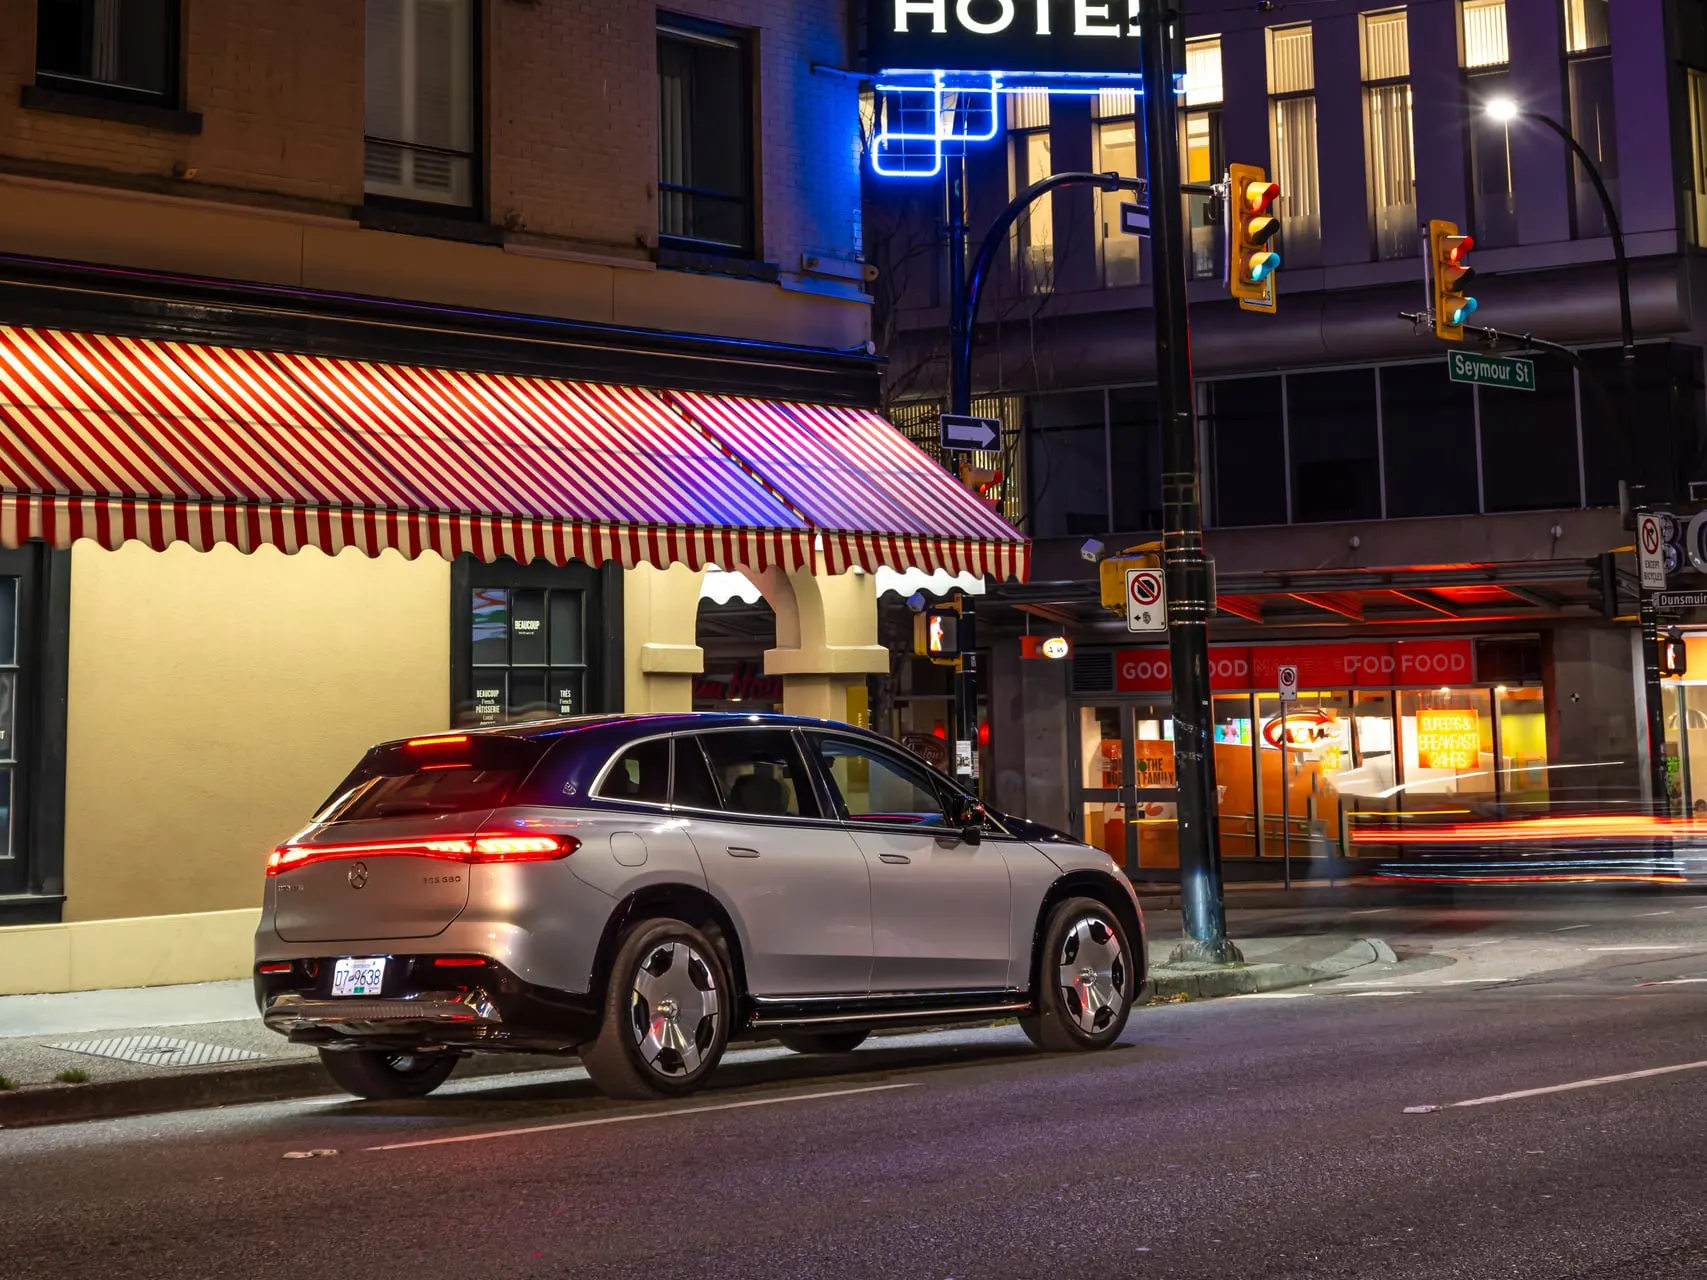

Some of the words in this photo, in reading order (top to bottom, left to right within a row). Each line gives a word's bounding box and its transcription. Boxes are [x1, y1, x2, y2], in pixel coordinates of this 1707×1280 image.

[1455, 354, 1511, 380] Seymour
[1516, 362, 1529, 382] St
[1661, 593, 1707, 606] Dunsmuir
[514, 620, 540, 630] BEAUCOUP
[1122, 661, 1168, 680] GOO
[1402, 654, 1465, 672] FOOD
